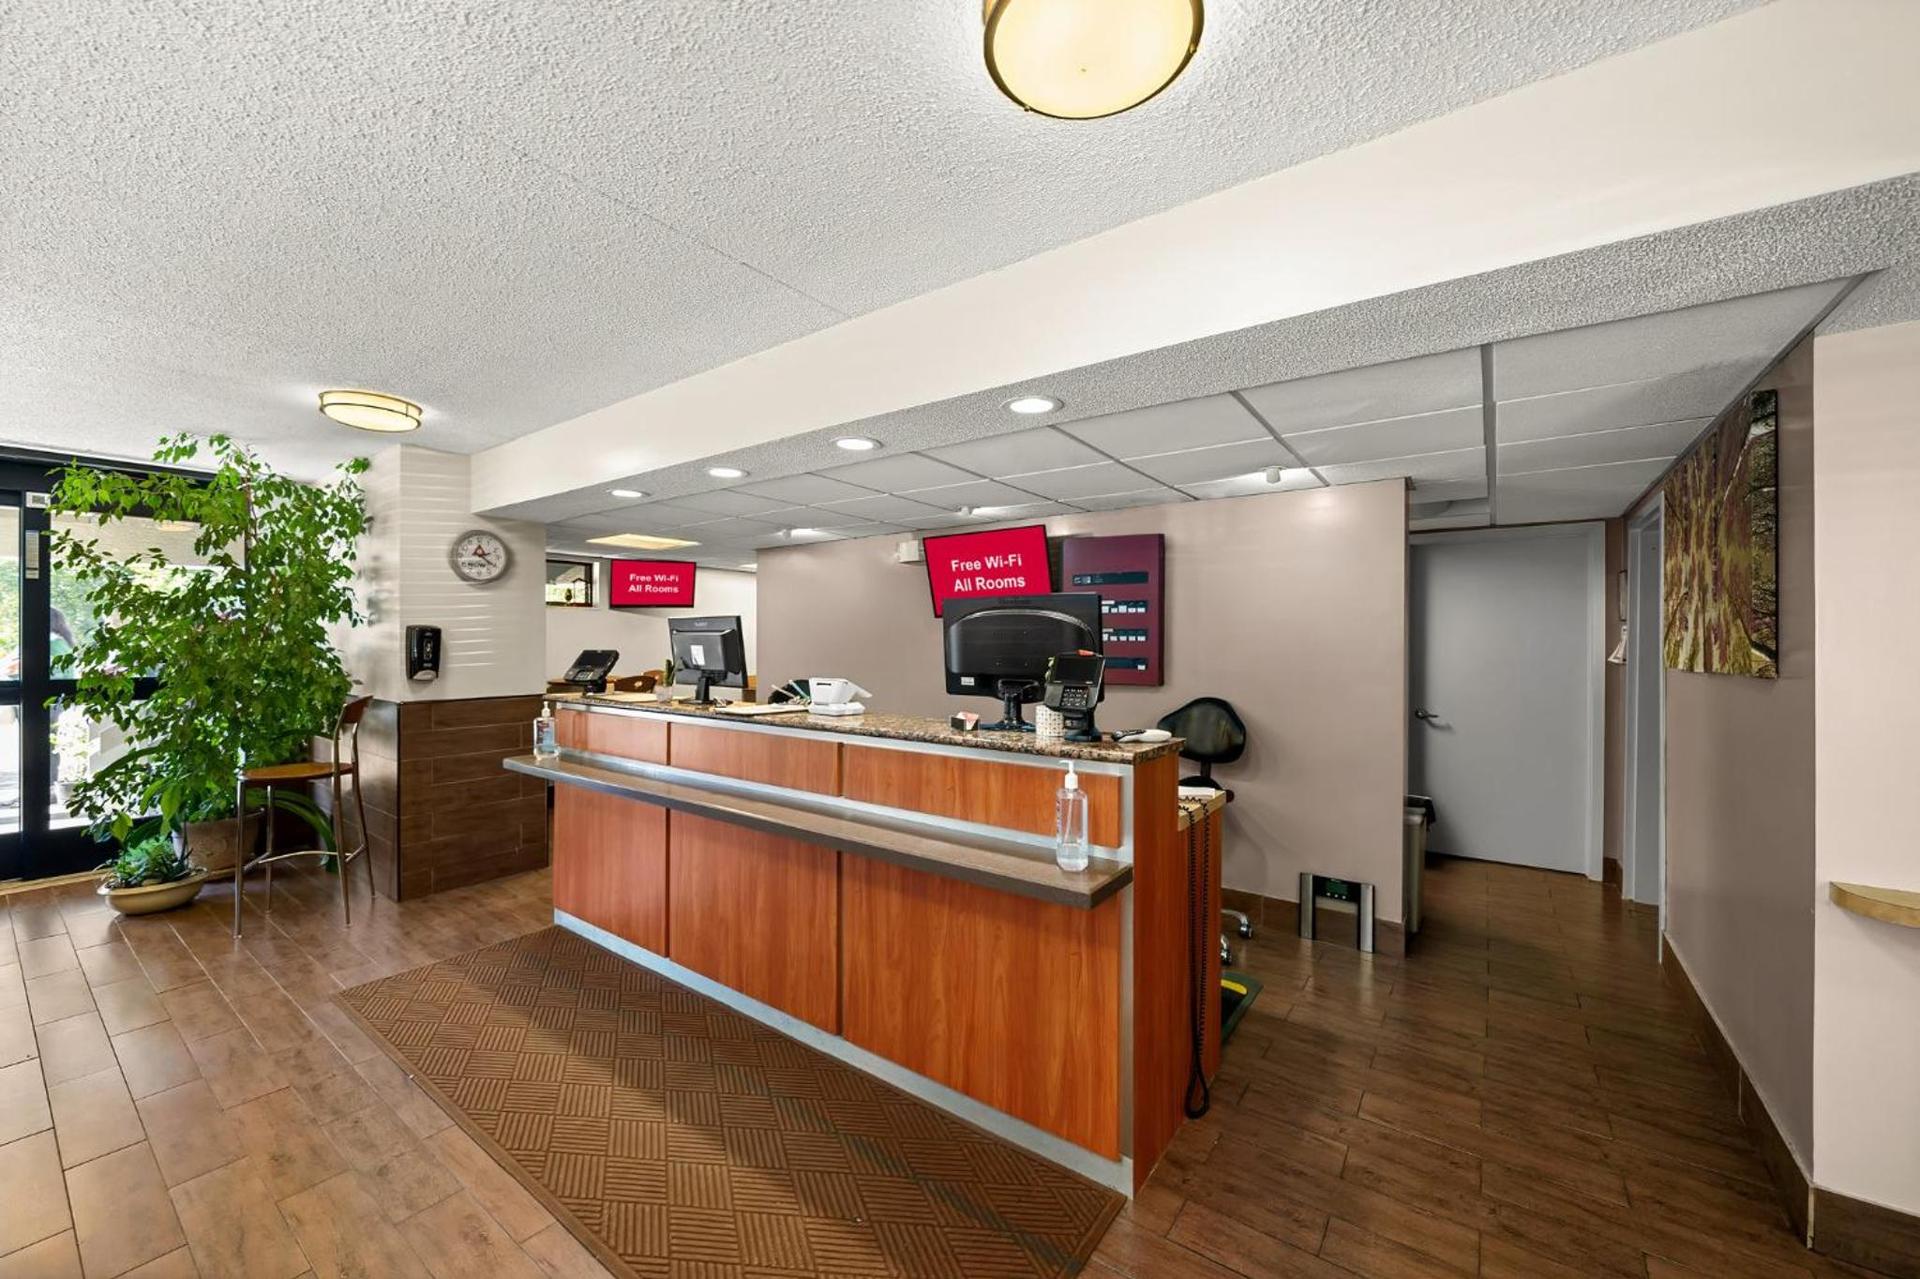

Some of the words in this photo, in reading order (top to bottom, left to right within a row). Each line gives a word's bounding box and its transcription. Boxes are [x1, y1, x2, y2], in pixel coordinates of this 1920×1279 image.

[951, 559, 981, 572] Free
[984, 553, 1023, 569] Wi-Fi
[629, 573, 652, 581] Free
[654, 574, 679, 582] Wi-Fi
[628, 584, 642, 592] All
[644, 584, 680, 593] Rooms
[954, 578, 973, 592] All
[975, 576, 1026, 591] Rooms
